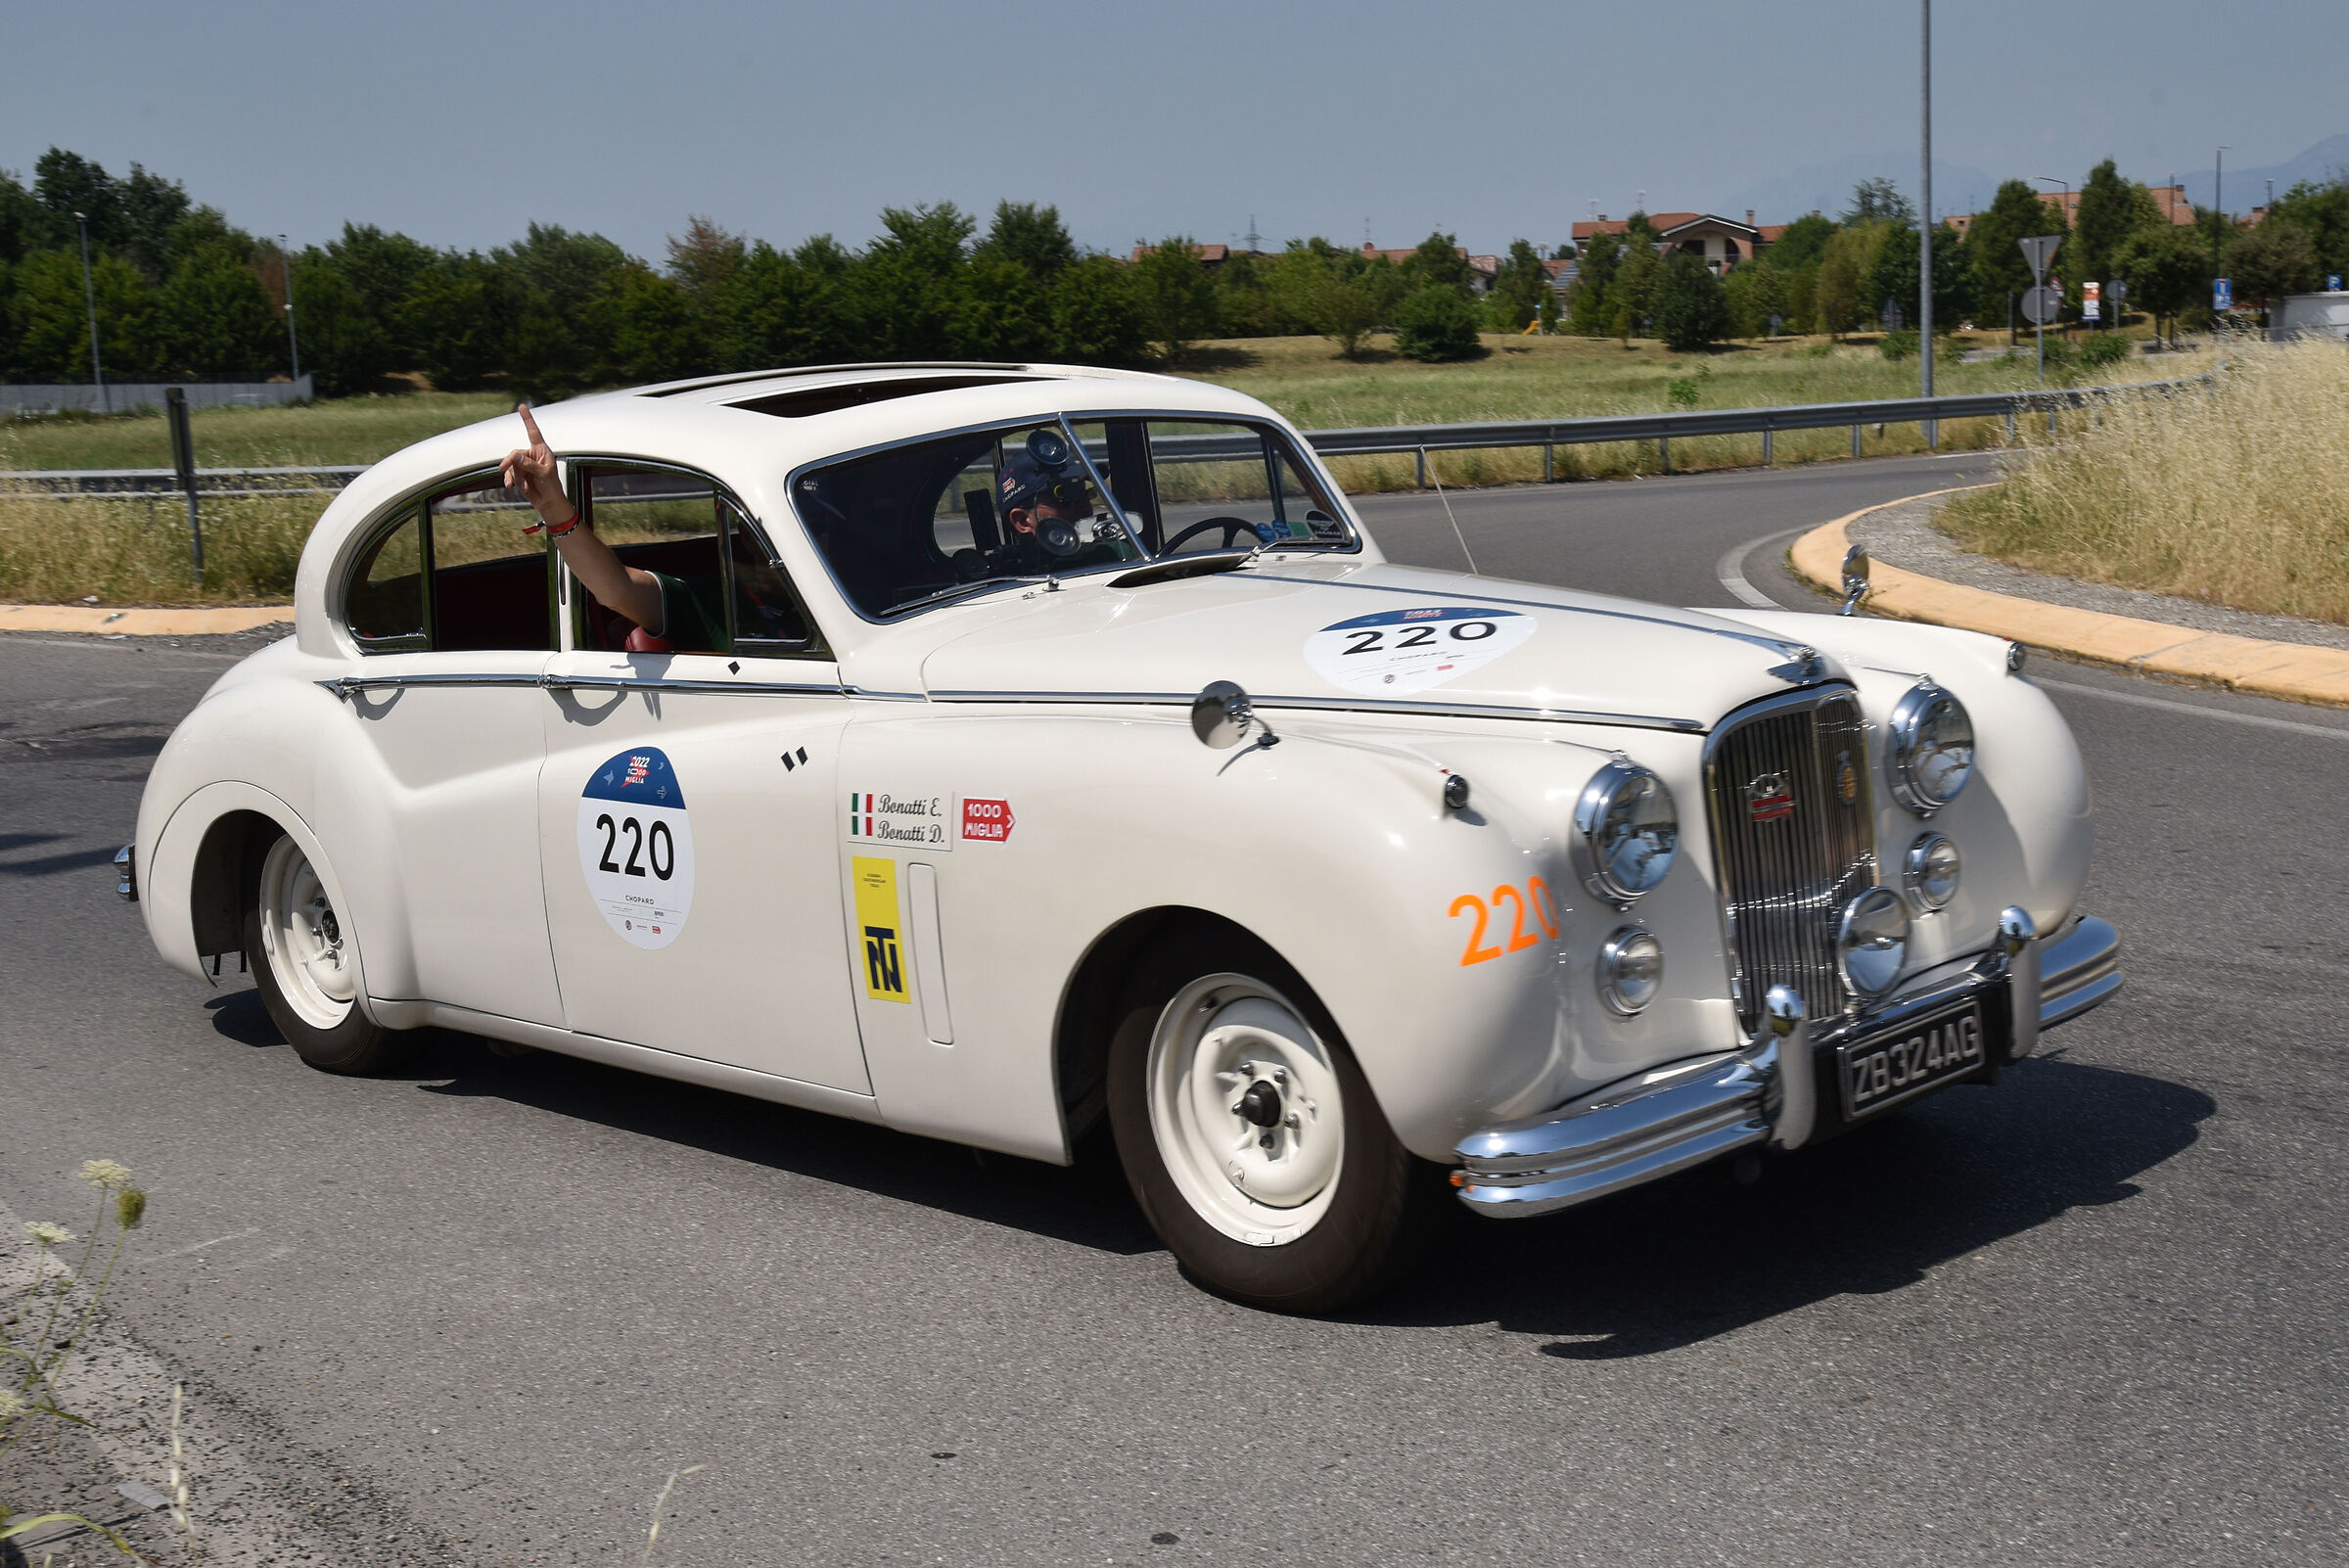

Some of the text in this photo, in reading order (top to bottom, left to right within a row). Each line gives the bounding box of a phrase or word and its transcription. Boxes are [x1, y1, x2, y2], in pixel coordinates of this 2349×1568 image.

[1342, 622, 1497, 656] 220
[627, 767, 647, 776] 1000
[628, 756, 651, 768] 2022
[877, 794, 943, 817] Bonatti E.
[967, 803, 1002, 818] 1000
[877, 820, 945, 844] Bonatti D.
[964, 822, 1004, 838] MIGLIA
[595, 813, 674, 882] 220
[625, 895, 655, 905] CHOPARD
[1448, 875, 1560, 967] 220
